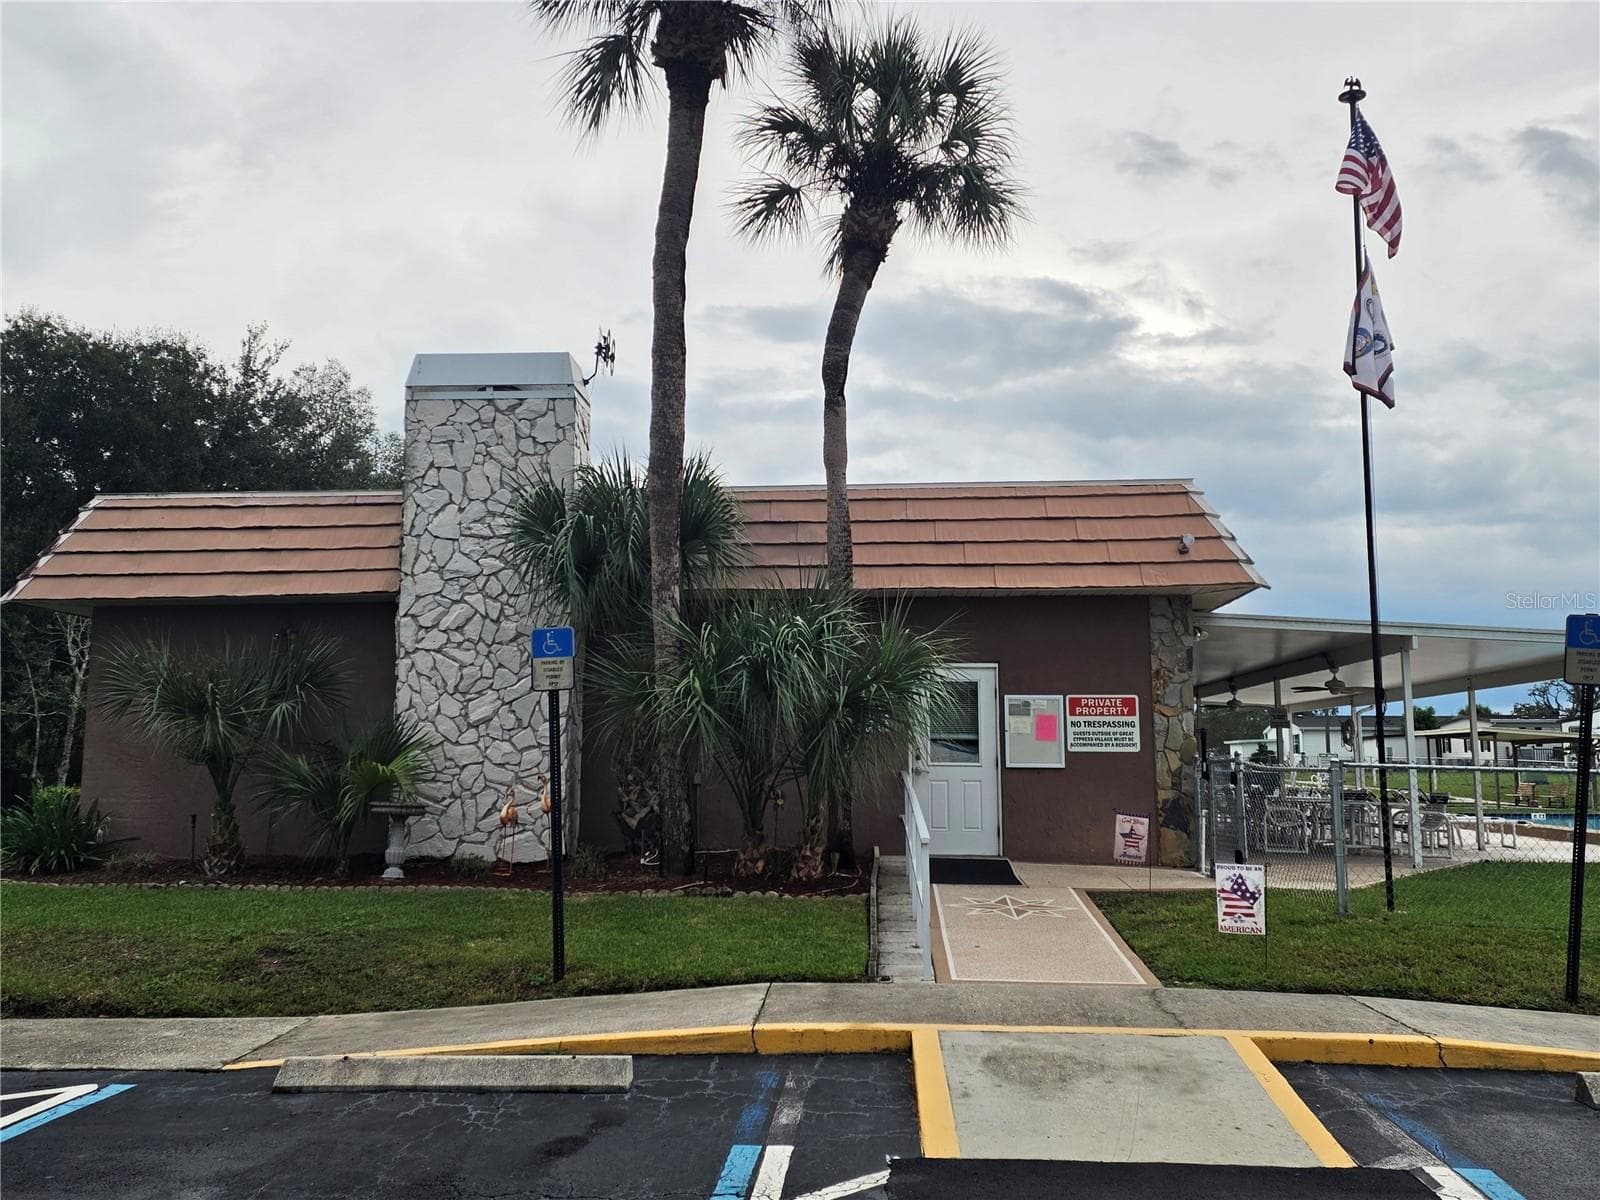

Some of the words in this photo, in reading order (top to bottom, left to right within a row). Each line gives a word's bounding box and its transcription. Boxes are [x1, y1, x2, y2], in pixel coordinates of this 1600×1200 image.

[1081, 699, 1123, 707] PRIVATE
[1075, 707, 1129, 715] PROPERTY
[1070, 720, 1082, 728] NO
[1083, 720, 1136, 728] TRESPASSING
[1219, 925, 1263, 935] AMERICAN
